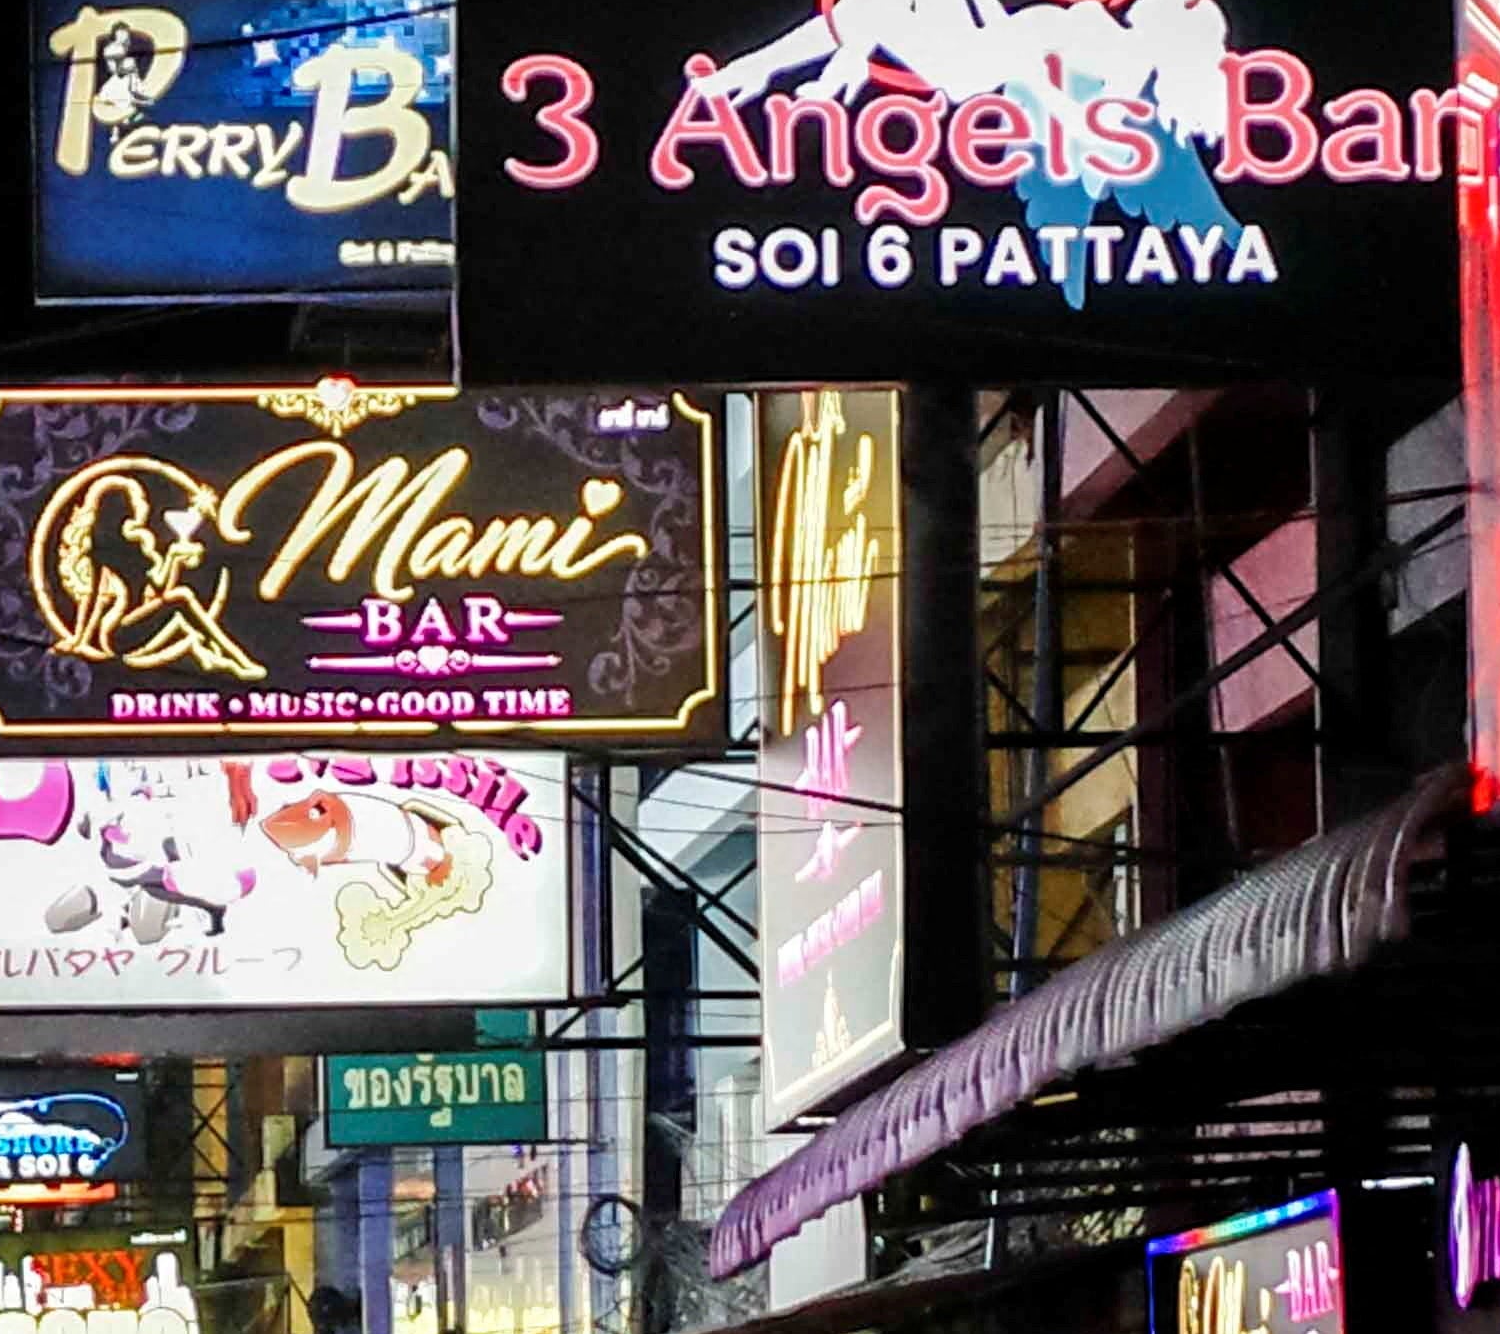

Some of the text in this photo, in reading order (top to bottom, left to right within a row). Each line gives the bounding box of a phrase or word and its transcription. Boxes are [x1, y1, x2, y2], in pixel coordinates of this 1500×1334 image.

[500, 48, 1464, 227] 3 Angels Bar
[713, 224, 1281, 289] SOI 6 PATTAYA
[219, 441, 646, 601] Mami
[362, 597, 511, 647] BAR
[111, 686, 571, 721] DRINK MUSIC GOOD TIME
[18, 1155, 70, 1179] SOI
[78, 1154, 96, 1177] 6
[1287, 1241, 1334, 1322] BAR
